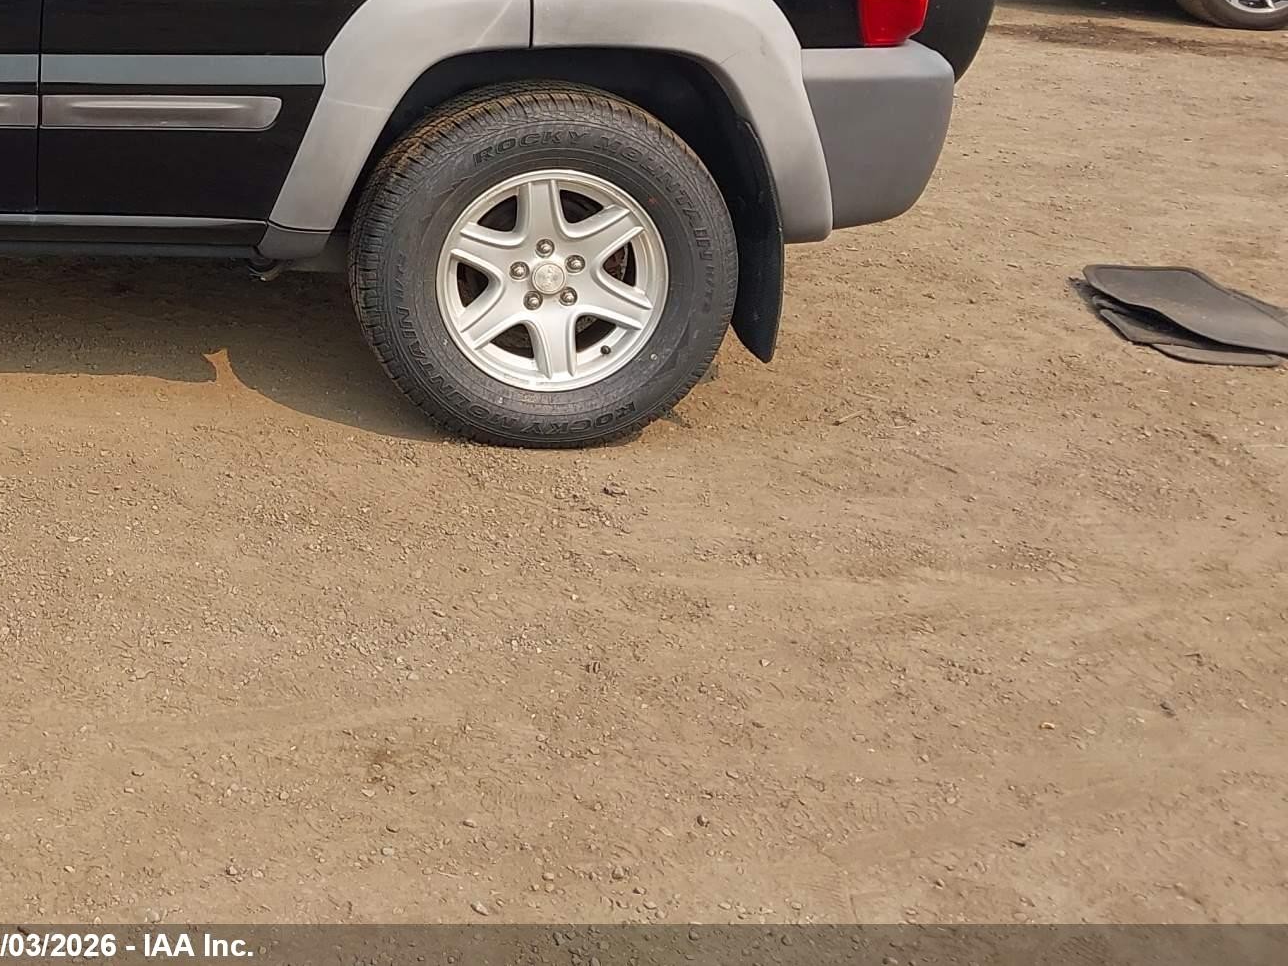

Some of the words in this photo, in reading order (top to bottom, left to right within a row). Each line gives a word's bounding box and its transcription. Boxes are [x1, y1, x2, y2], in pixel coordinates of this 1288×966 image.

[471, 131, 590, 166] ROCKY
[593, 135, 712, 262] MOUNTAIN
[396, 305, 519, 430] MOUNTAIN
[521, 401, 637, 433] ROCKY
